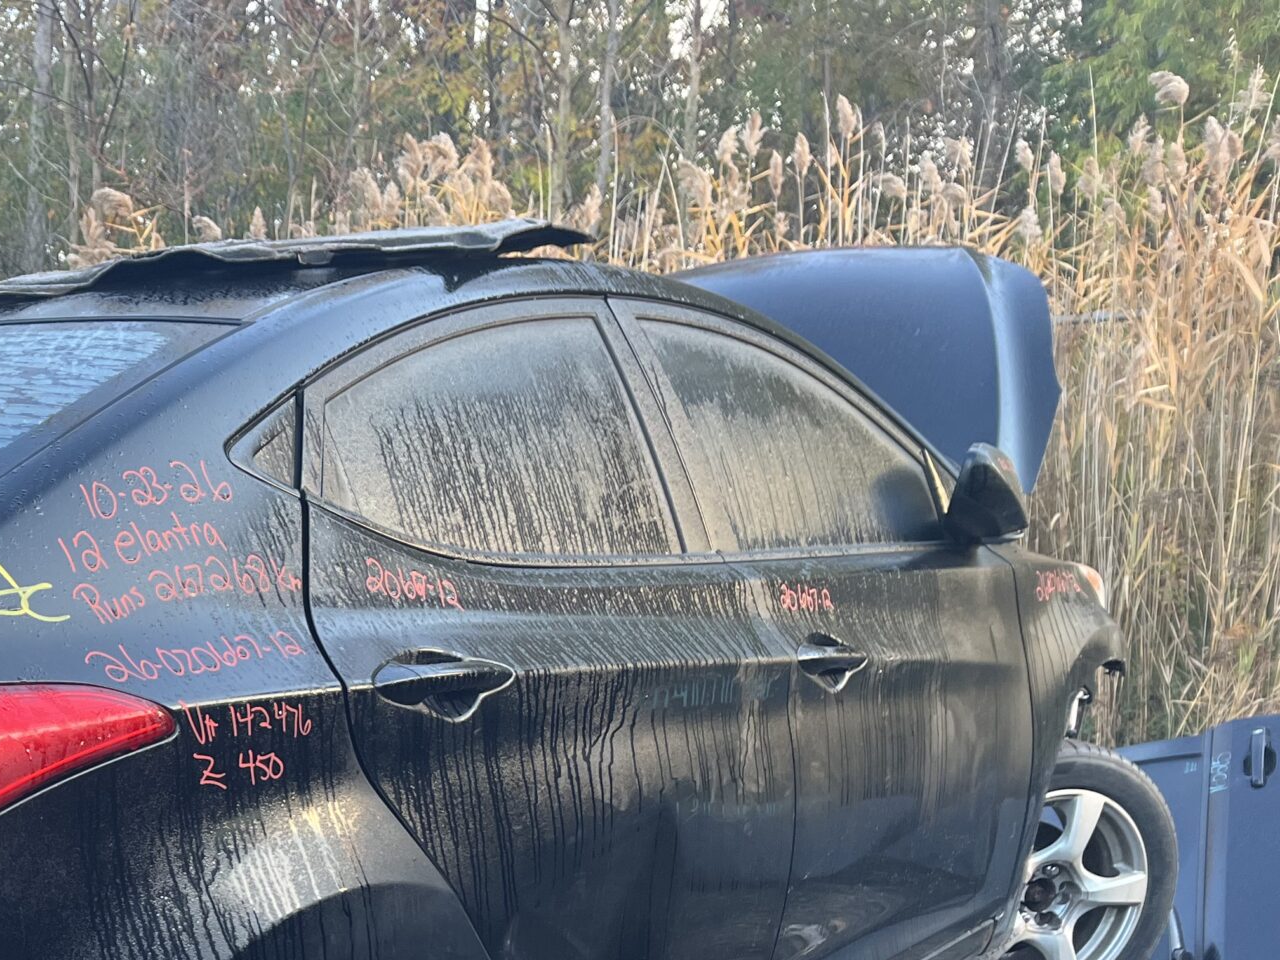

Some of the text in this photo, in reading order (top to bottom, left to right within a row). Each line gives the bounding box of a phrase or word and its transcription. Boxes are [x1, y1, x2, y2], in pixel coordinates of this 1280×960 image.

[57, 530, 109, 574] 12
[72, 582, 146, 625] Runs
[238, 749, 284, 786] 450
